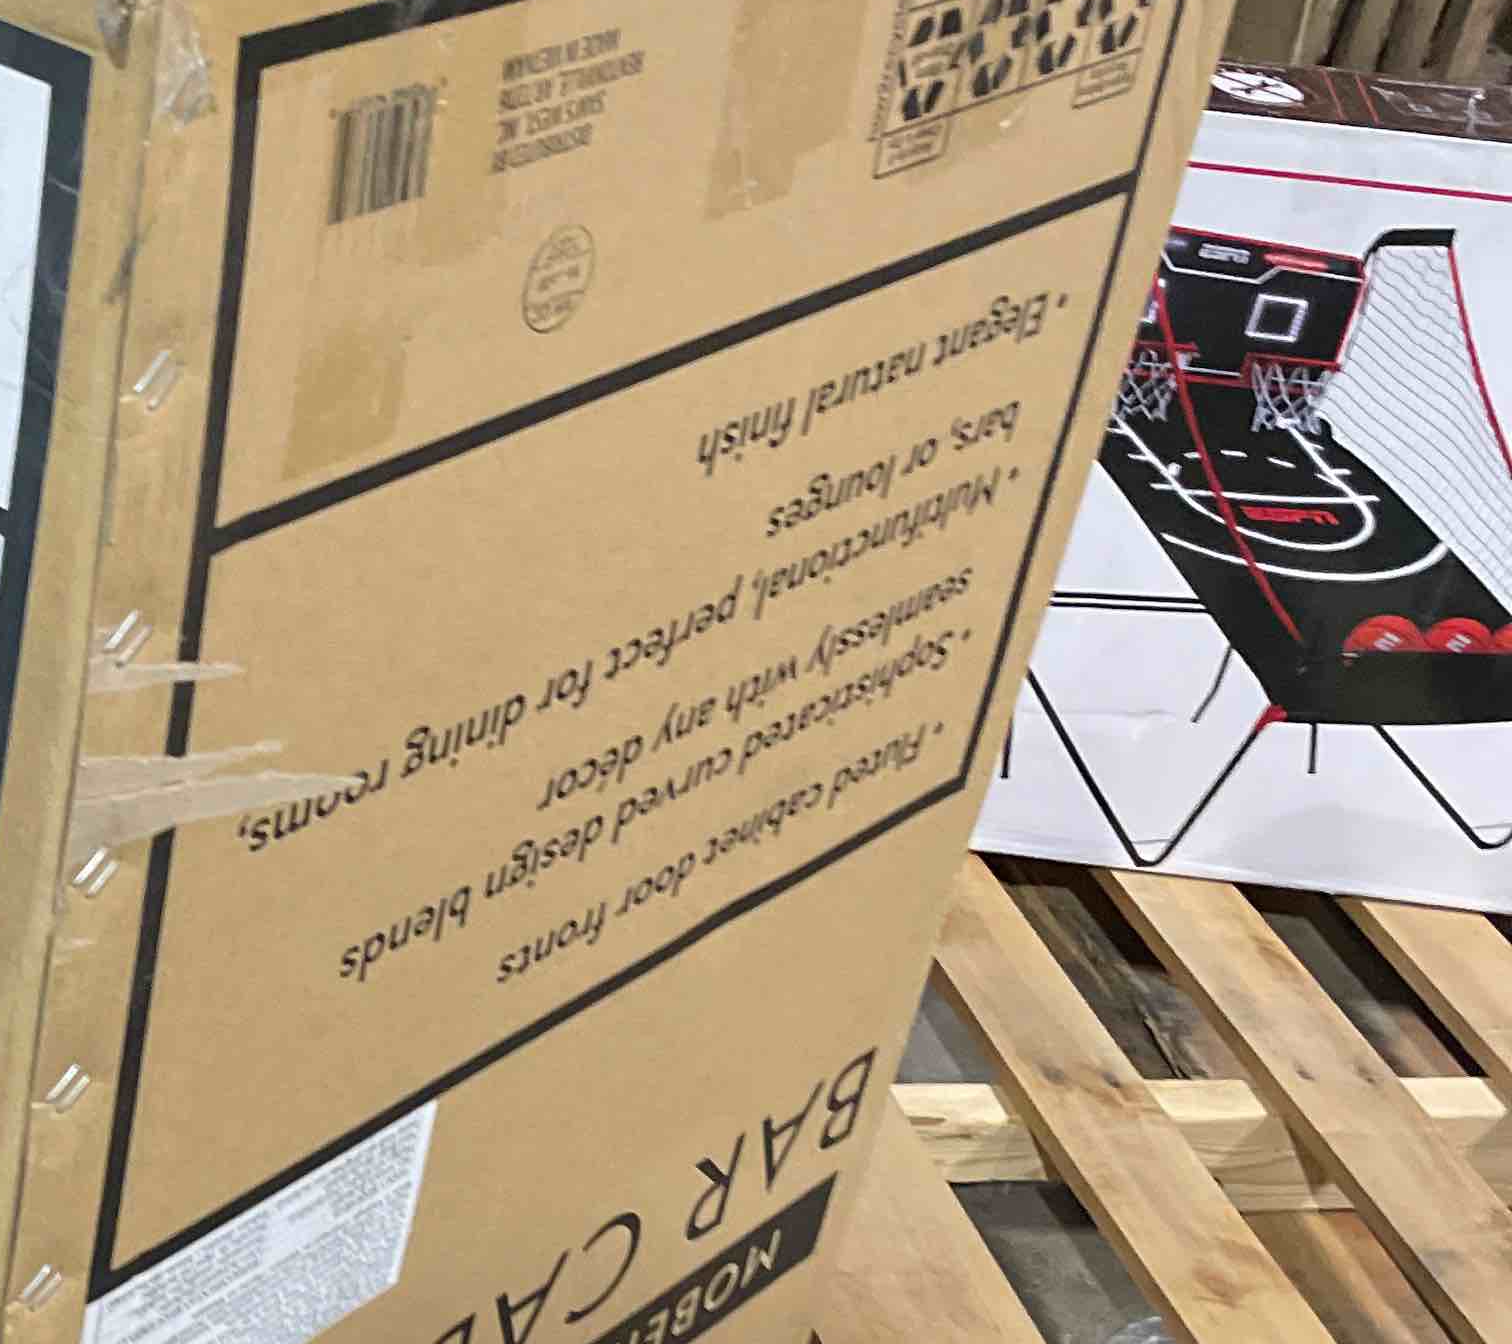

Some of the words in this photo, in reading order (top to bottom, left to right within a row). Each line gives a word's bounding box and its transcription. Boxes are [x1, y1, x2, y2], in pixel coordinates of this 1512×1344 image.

[933, 289, 1048, 365] Elegant
[804, 342, 925, 424] natural
[696, 398, 799, 476] finish
[902, 436, 939, 475] or
[950, 399, 1020, 453] bars,
[748, 469, 1000, 610] Multifunctional,
[764, 458, 897, 540] lounges
[604, 586, 744, 682] perfect
[805, 565, 974, 680] seamlessly
[535, 657, 596, 715] for
[653, 693, 718, 751] any
[724, 655, 800, 719] with
[738, 627, 955, 777] Sophisticated
[402, 692, 527, 782] dining
[536, 734, 644, 812] décor
[829, 720, 927, 796] Fluted
[235, 757, 390, 853] rooms,
[615, 745, 733, 824] curved
[702, 780, 823, 870] cabinet
[484, 809, 605, 895] design
[615, 849, 696, 916] door
[338, 882, 472, 983] blends
[494, 903, 607, 985] fronts
[684, 1046, 877, 1241] BAR
